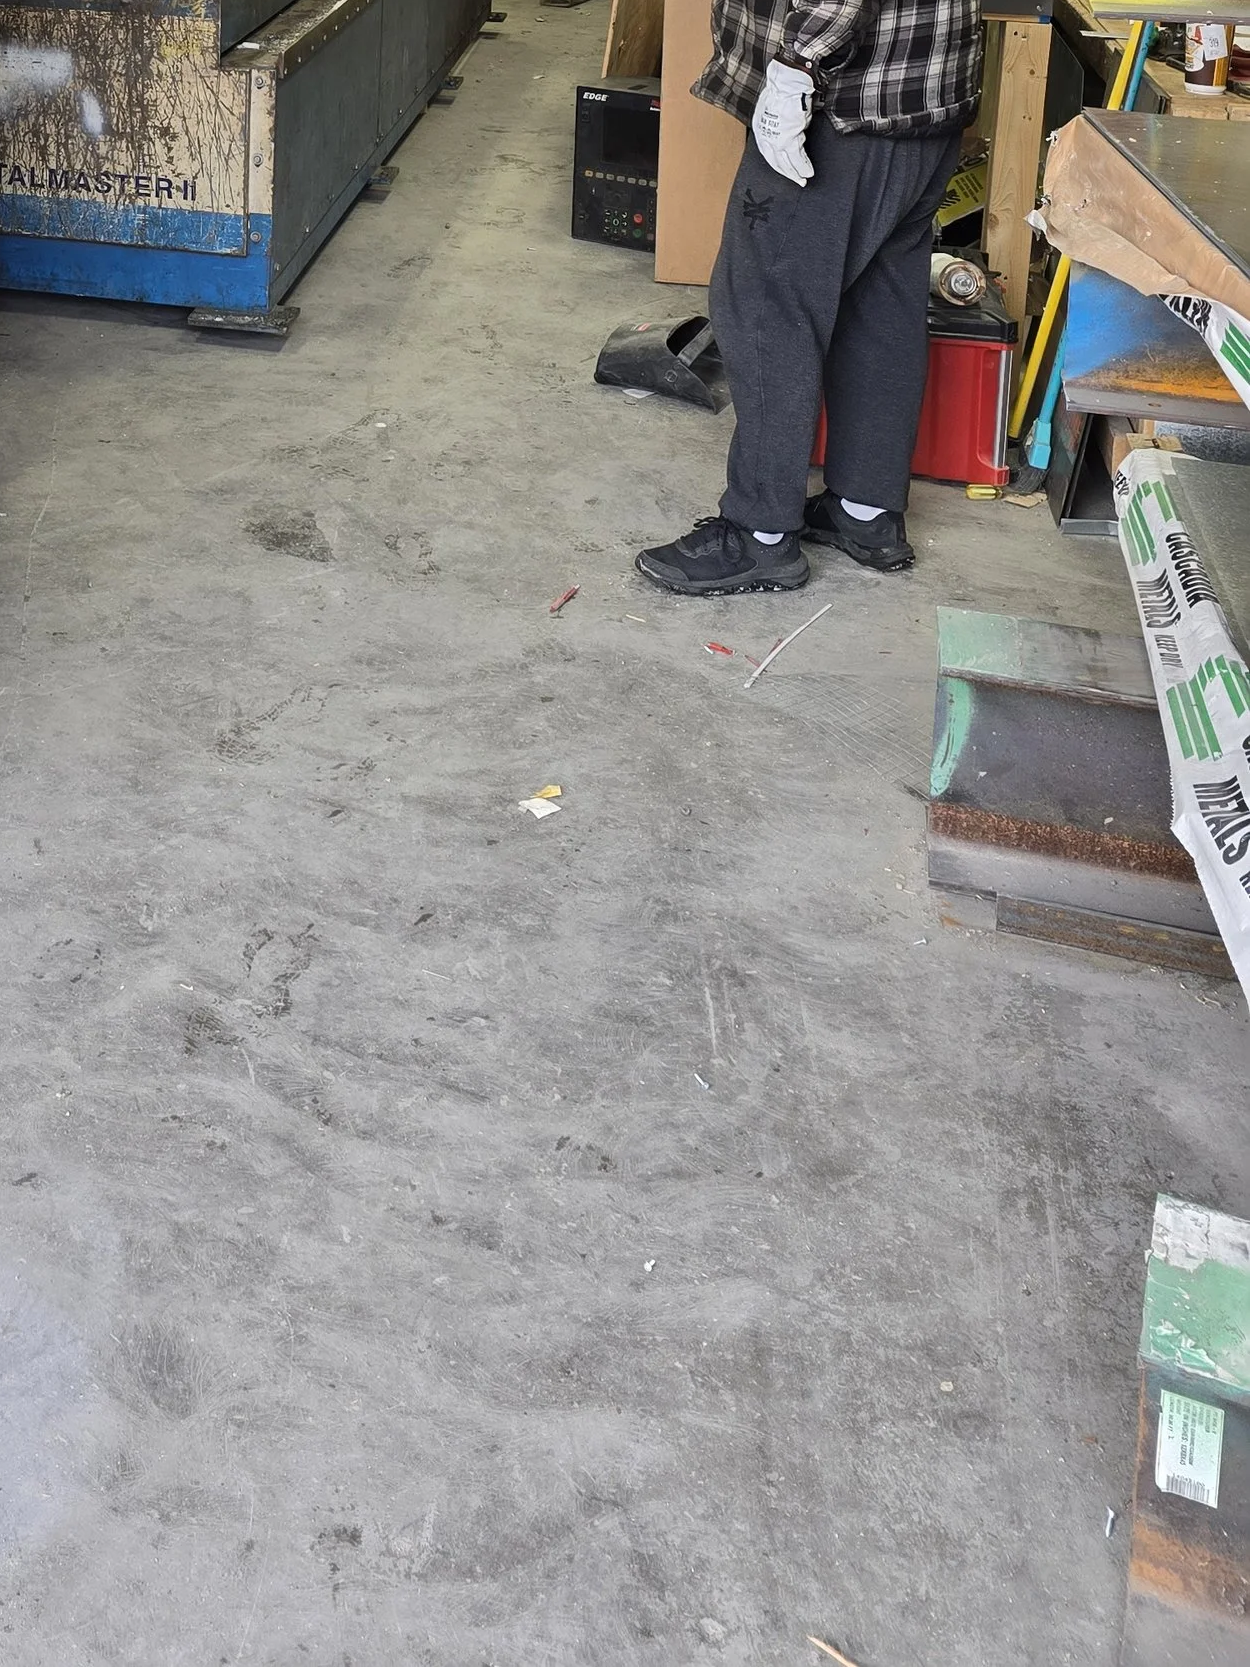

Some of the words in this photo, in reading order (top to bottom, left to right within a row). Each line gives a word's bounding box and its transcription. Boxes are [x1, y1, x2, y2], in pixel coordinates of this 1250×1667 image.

[583, 92, 608, 102] EDGE
[1136, 568, 1182, 629] METALS
[1165, 532, 1219, 609] CASCADIA
[1192, 774, 1250, 866] METALS
